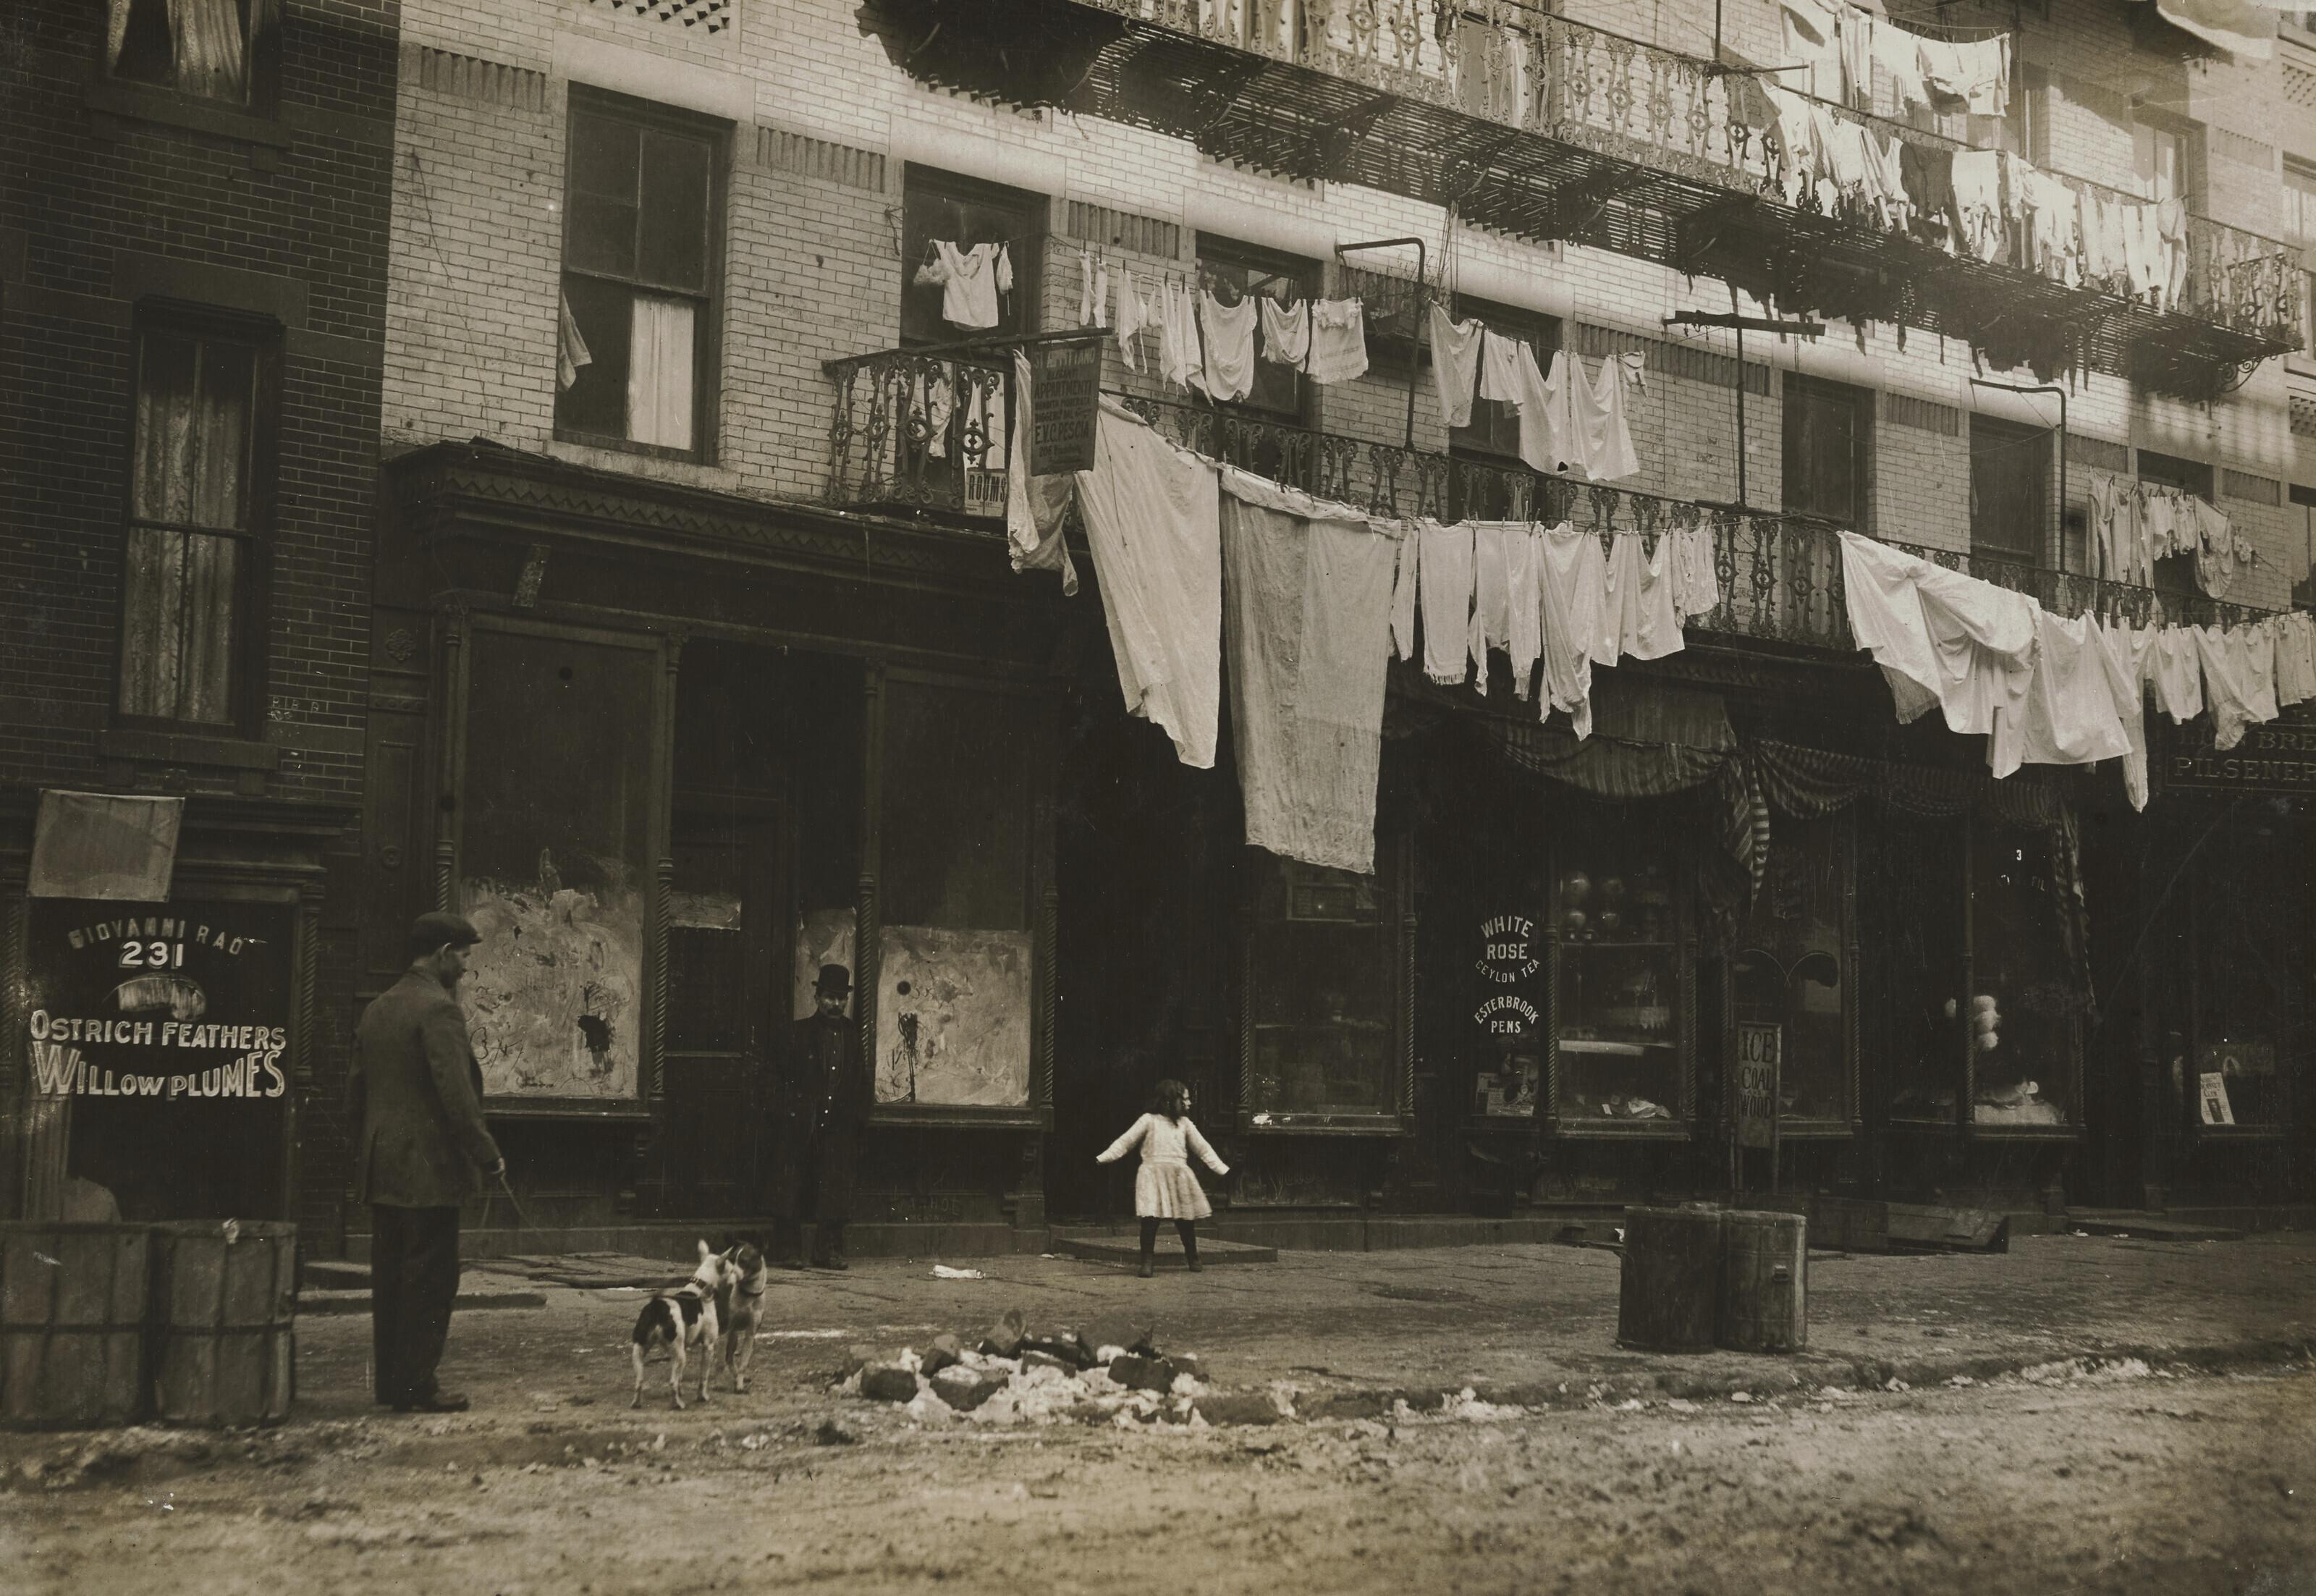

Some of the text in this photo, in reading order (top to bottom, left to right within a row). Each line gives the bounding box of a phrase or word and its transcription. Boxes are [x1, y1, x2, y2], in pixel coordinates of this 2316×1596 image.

[968, 474, 1007, 502] ROOMS
[1479, 915, 1534, 940] WHITE
[118, 940, 185, 969] 231
[1486, 942, 1528, 960] ROSE
[1476, 959, 1541, 984] CEYLON TEA
[1474, 995, 1540, 1025] ESTERBROOK
[30, 1009, 287, 1052] OSTRICH FEATHERS
[1490, 1020, 1522, 1034] PENS
[1741, 1031, 1775, 1063] ICE
[30, 1040, 287, 1099] WILLOW PLUMES
[1741, 1066, 1773, 1092] COAL
[1739, 1094, 1773, 1118] WOOD
